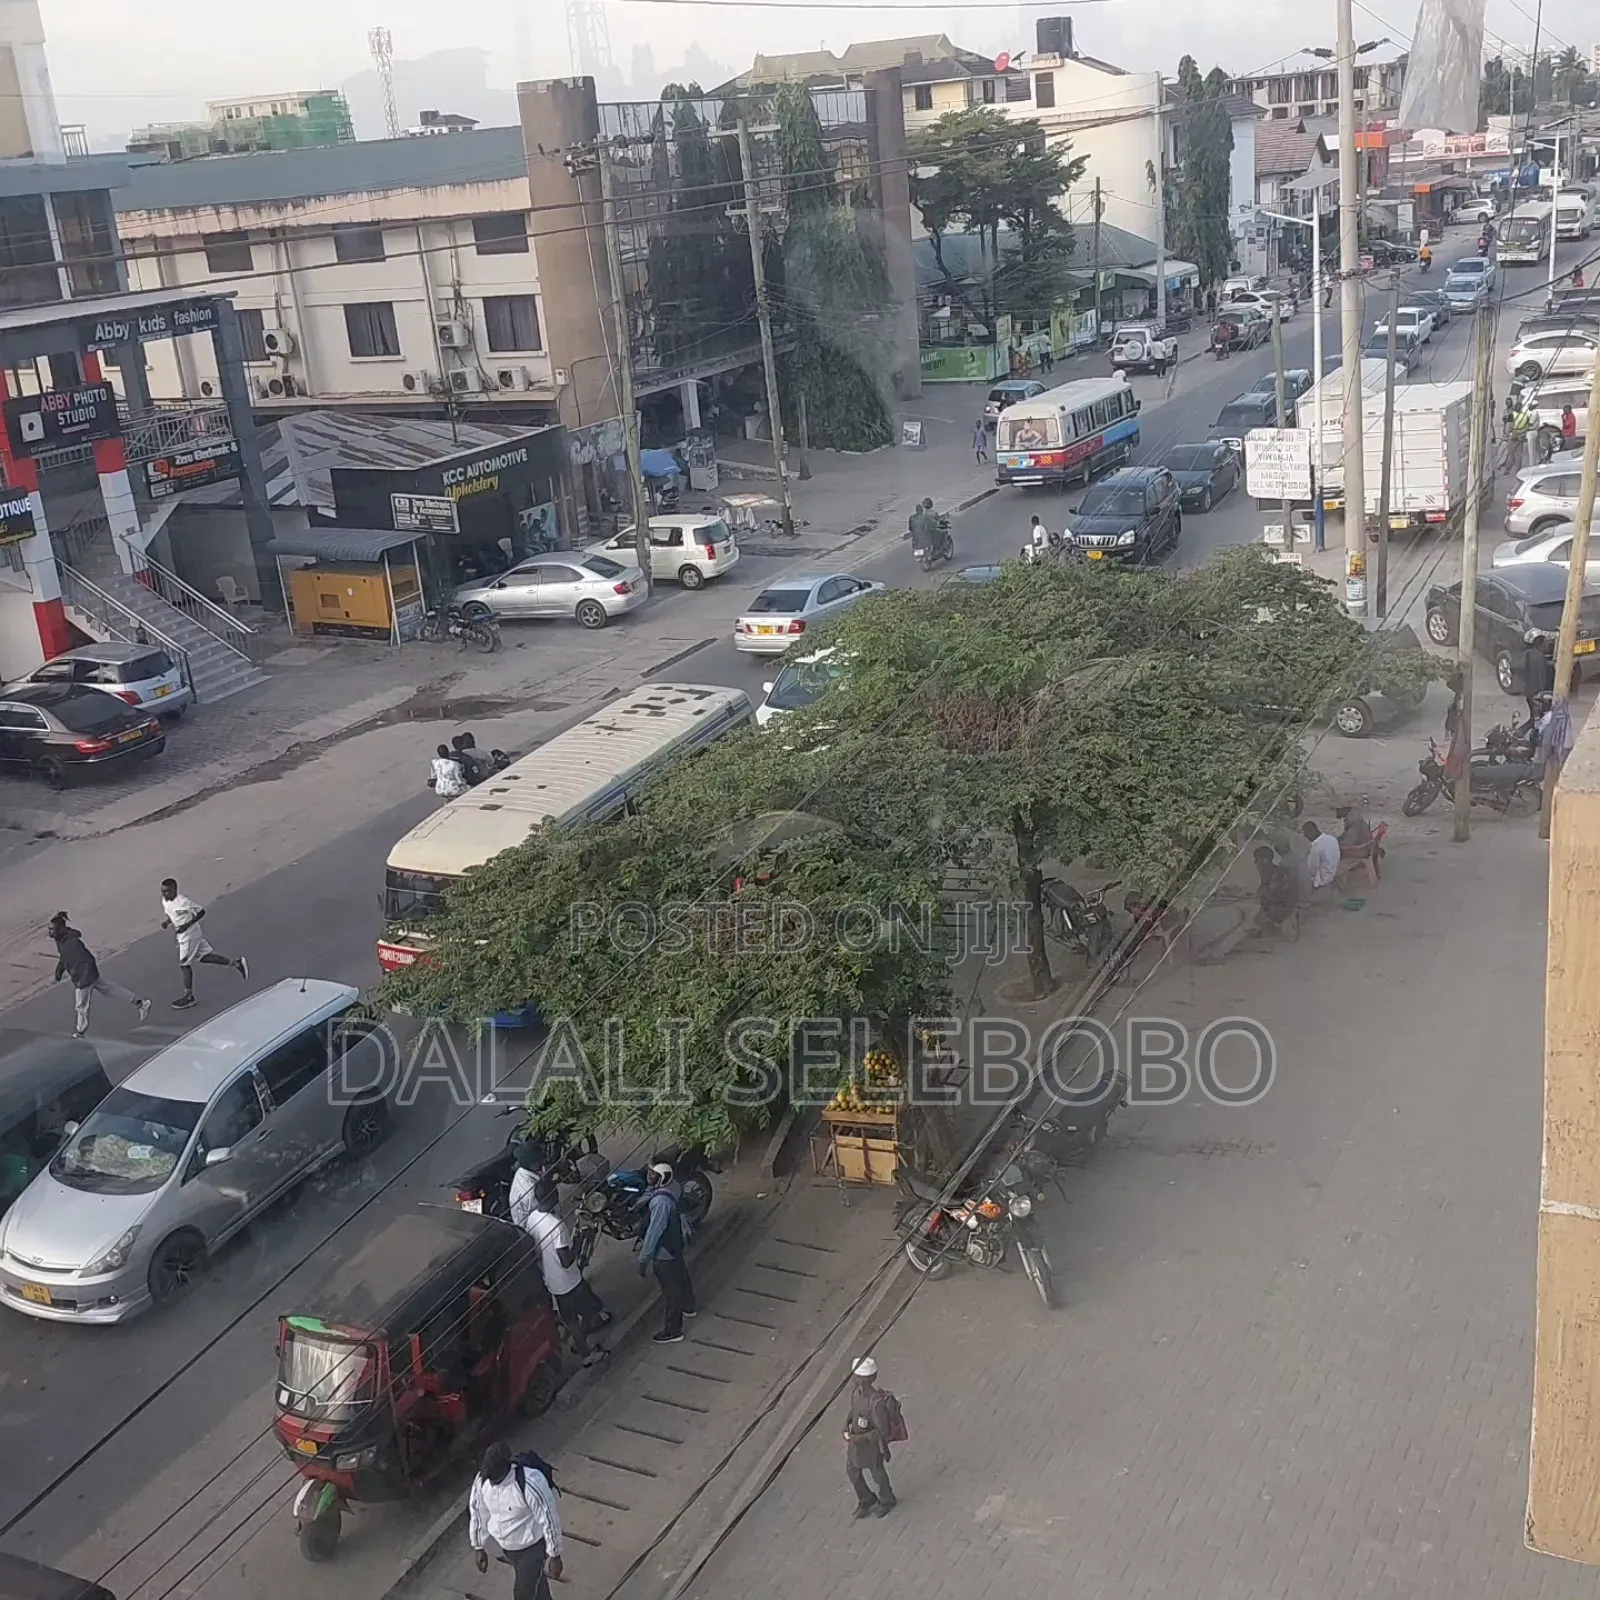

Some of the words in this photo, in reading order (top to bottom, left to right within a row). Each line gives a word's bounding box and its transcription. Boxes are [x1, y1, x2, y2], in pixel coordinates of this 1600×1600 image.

[95, 320, 130, 341] Abby
[139, 314, 166, 334] kids
[173, 308, 212, 326] fashion
[41, 392, 71, 413] ABBY
[73, 388, 107, 407] PHOTO
[57, 406, 97, 425] STUDIO
[442, 467, 465, 487] KCC
[466, 448, 529, 479] AUTOMOTIVE
